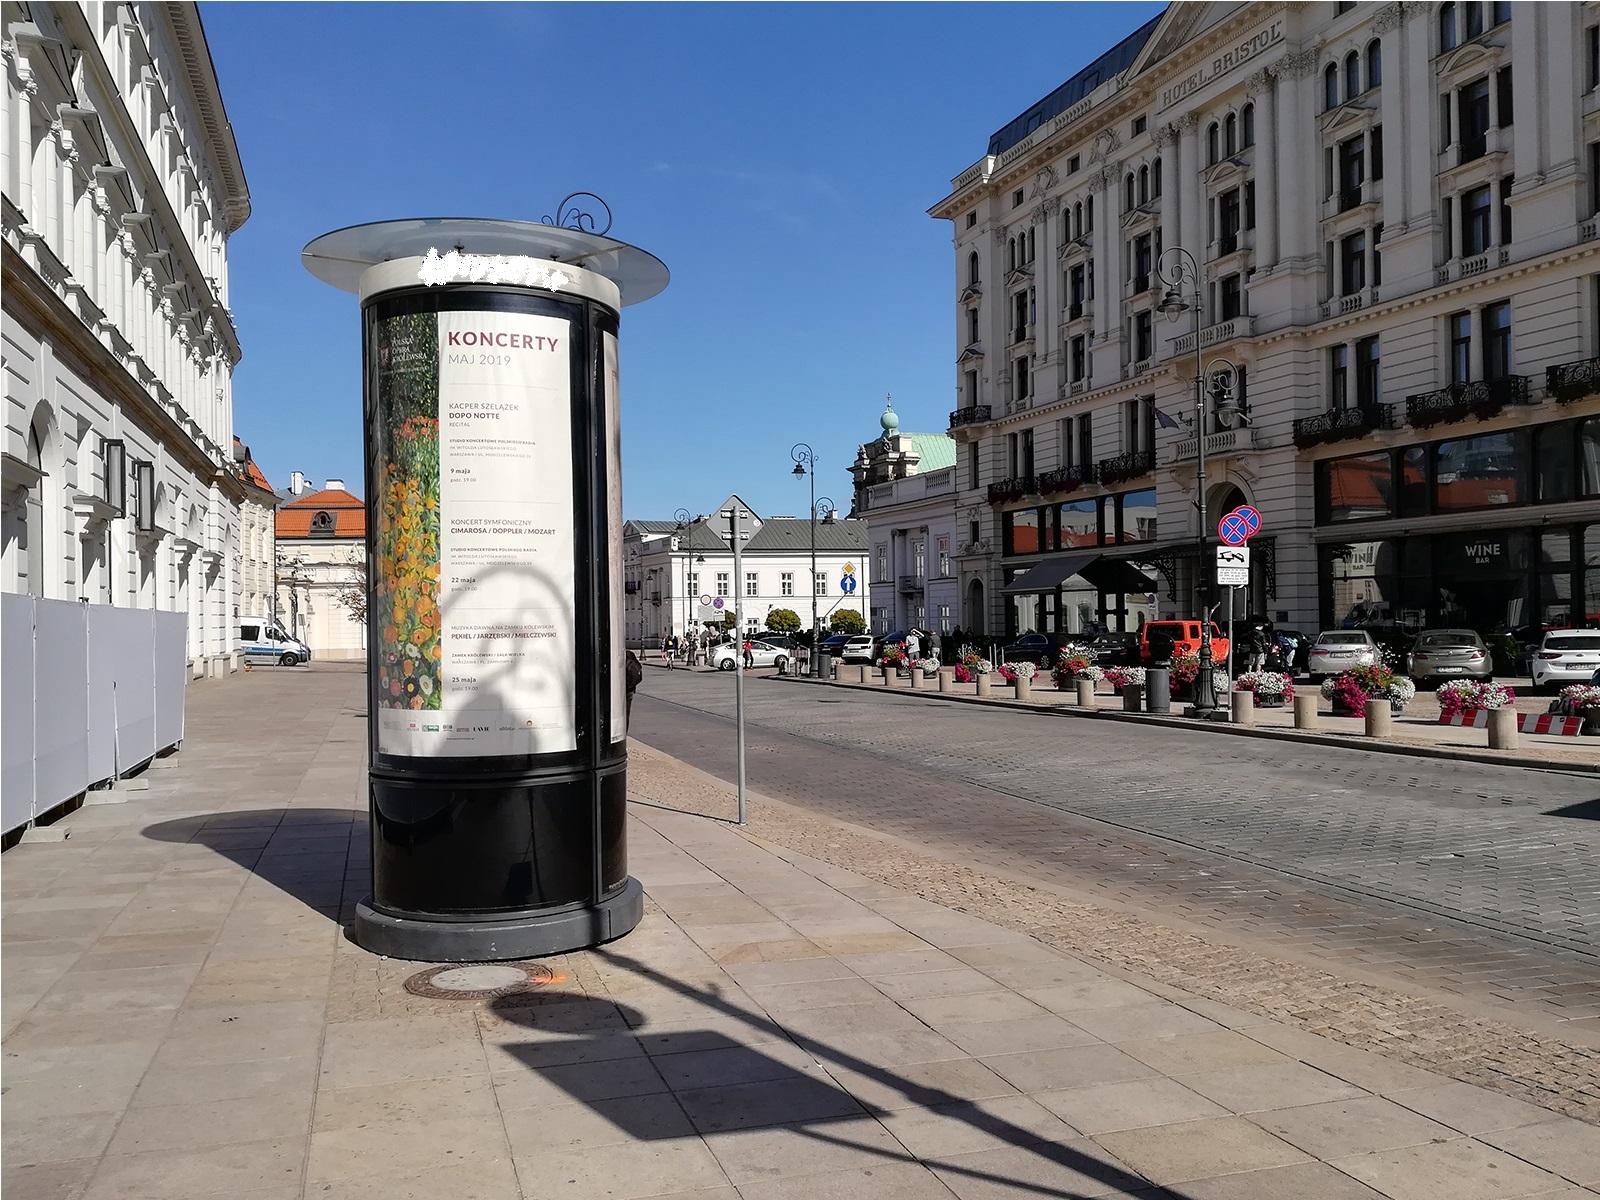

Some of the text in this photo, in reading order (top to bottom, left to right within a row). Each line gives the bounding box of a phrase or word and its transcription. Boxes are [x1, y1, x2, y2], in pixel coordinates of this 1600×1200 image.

[1163, 69, 1207, 106] HOTEL
[449, 331, 559, 352] KONCERTY
[449, 354, 511, 366] MAJ 2019
[473, 412, 500, 420] NOTTE
[493, 527, 523, 535] DOPPLER
[1465, 544, 1501, 557] WINE
